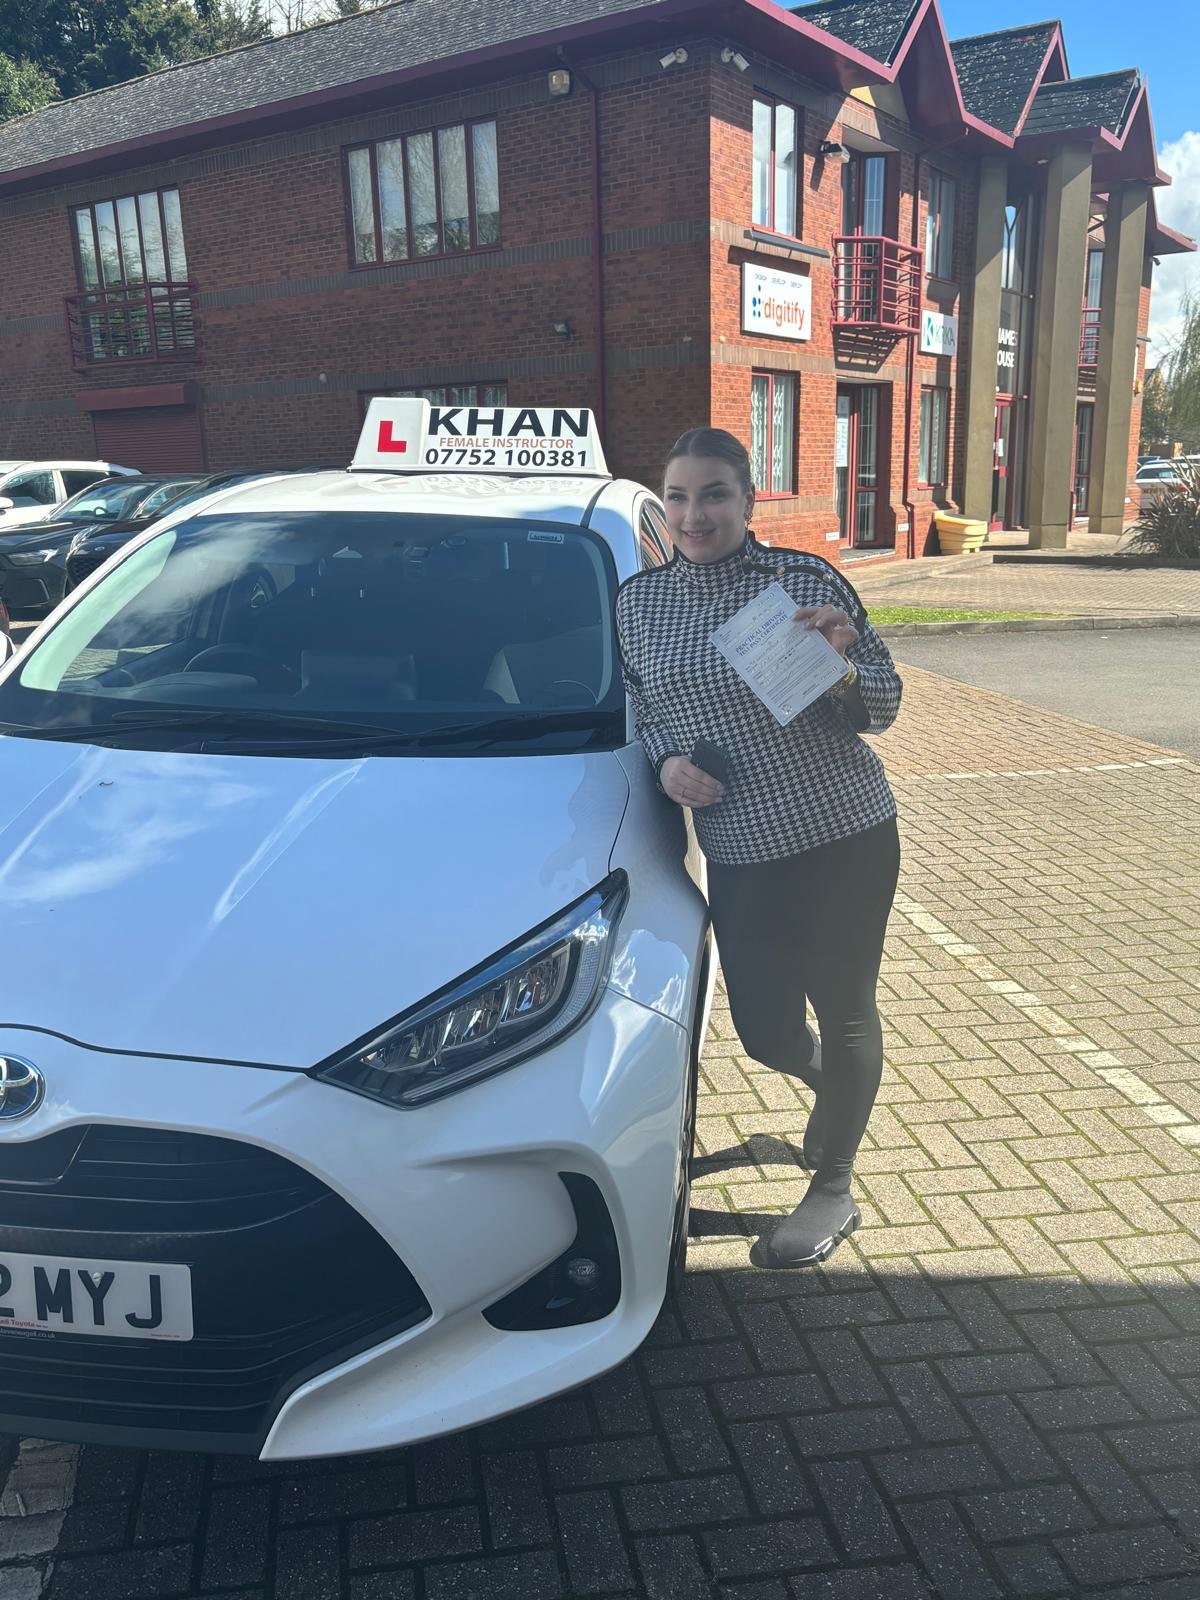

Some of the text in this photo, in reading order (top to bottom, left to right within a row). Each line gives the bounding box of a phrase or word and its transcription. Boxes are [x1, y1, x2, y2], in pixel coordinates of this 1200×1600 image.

[764, 297, 804, 330] digitify
[997, 350, 1014, 367] OUSE
[428, 407, 589, 437] KHAN
[377, 420, 408, 453] L
[439, 437, 574, 449] FEMALE INSTRUCTOR
[425, 448, 587, 467] 07752 100381
[34, 1266, 163, 1329] MYJ
[10, 1319, 36, 1328] Toyota
